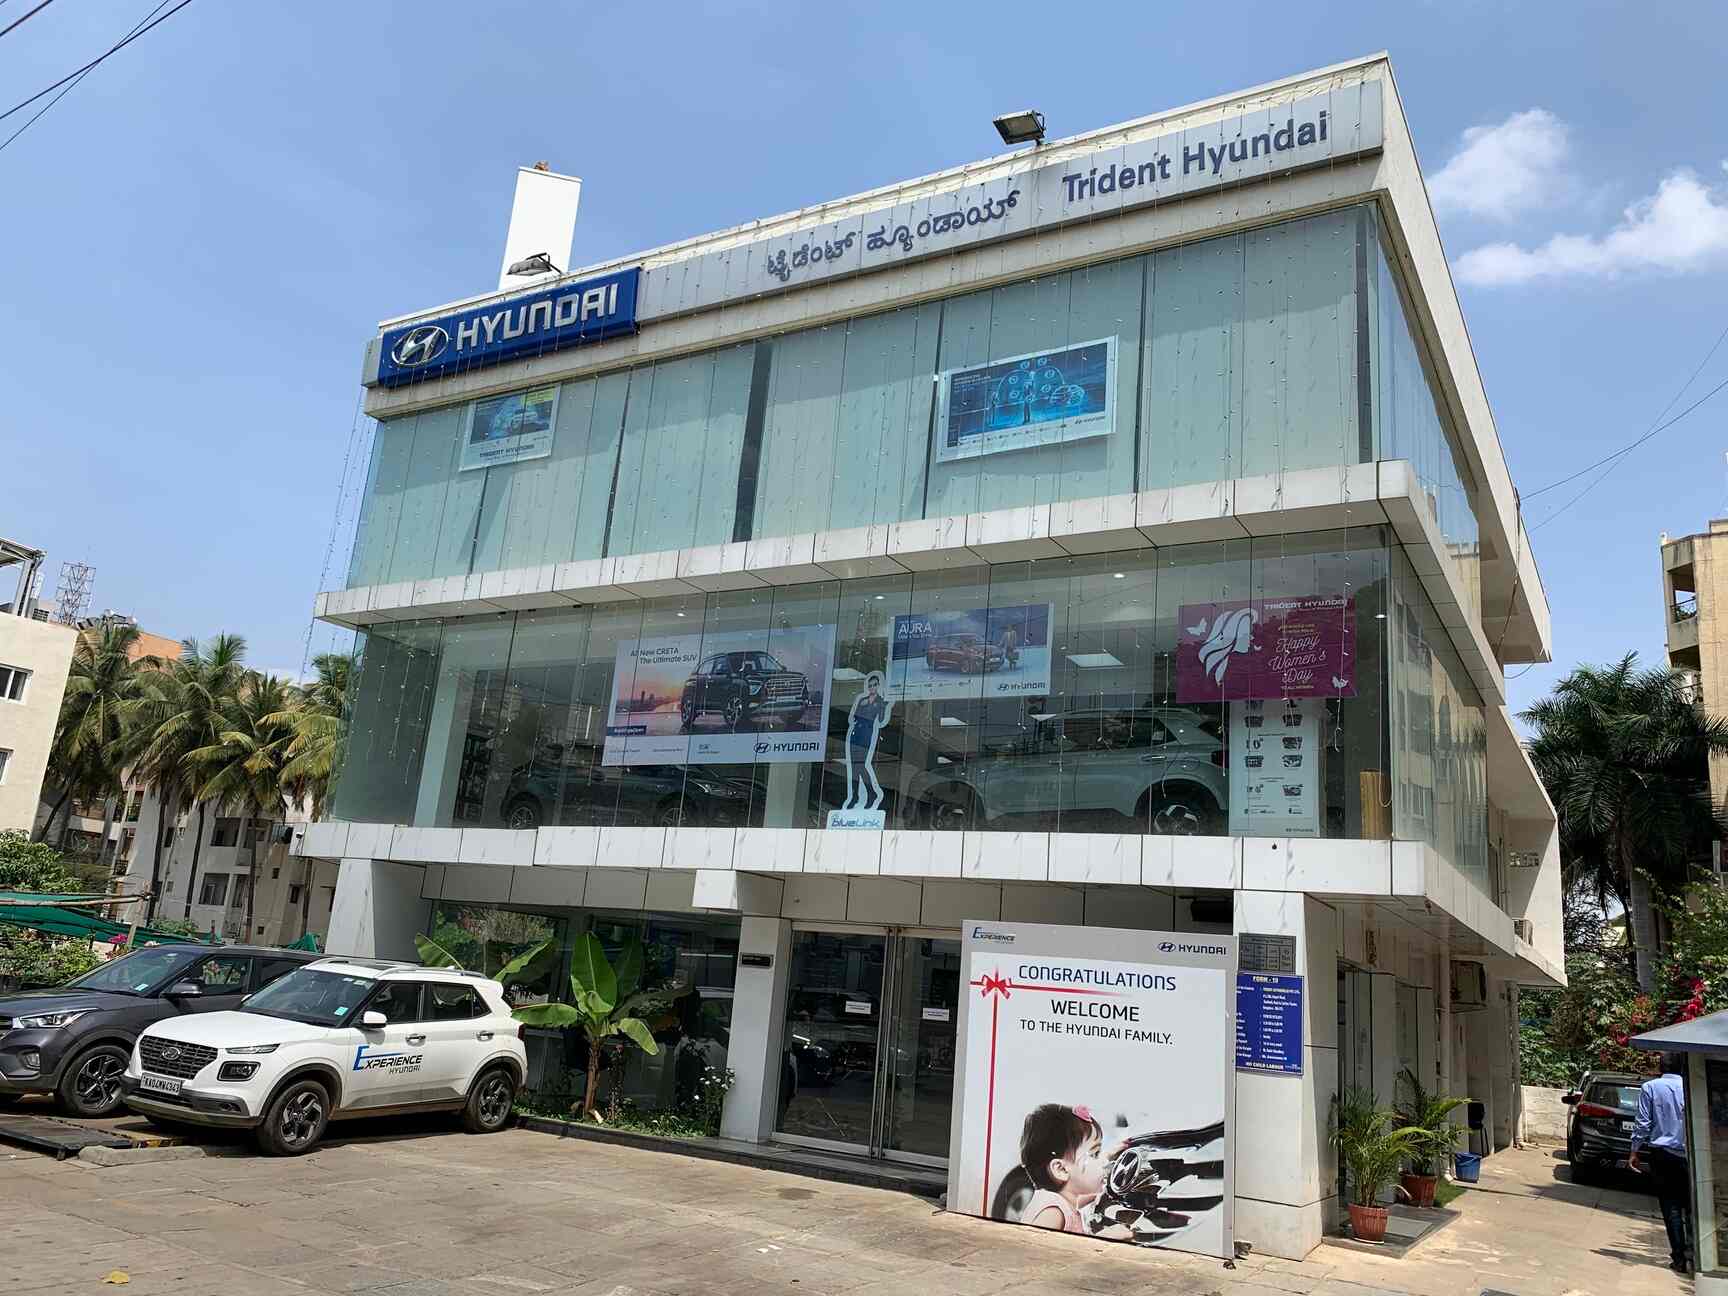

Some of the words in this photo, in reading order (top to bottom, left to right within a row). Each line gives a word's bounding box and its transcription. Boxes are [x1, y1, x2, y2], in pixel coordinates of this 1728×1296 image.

[1062, 153, 1171, 203] Trident
[1183, 110, 1328, 176] Hyundai
[456, 283, 619, 351] HYUNDAI
[898, 622, 932, 634] AURA
[656, 647, 679, 656] CRETA
[640, 657, 651, 665] The
[653, 655, 682, 664] Ultimate
[682, 655, 698, 663] SUV
[774, 742, 820, 752] HYUNDAI
[1178, 944, 1227, 955] HYUNDAI
[1018, 964, 1177, 991] CONGRATULATIONS
[1050, 999, 1140, 1022] WELCOME
[1020, 1019, 1036, 1031] TO
[1039, 1020, 1063, 1034] THE
[1066, 1023, 1122, 1039] HYUNDAI
[1125, 1030, 1174, 1045] FAMILY.
[388, 1065, 421, 1074] HYUNDAI
